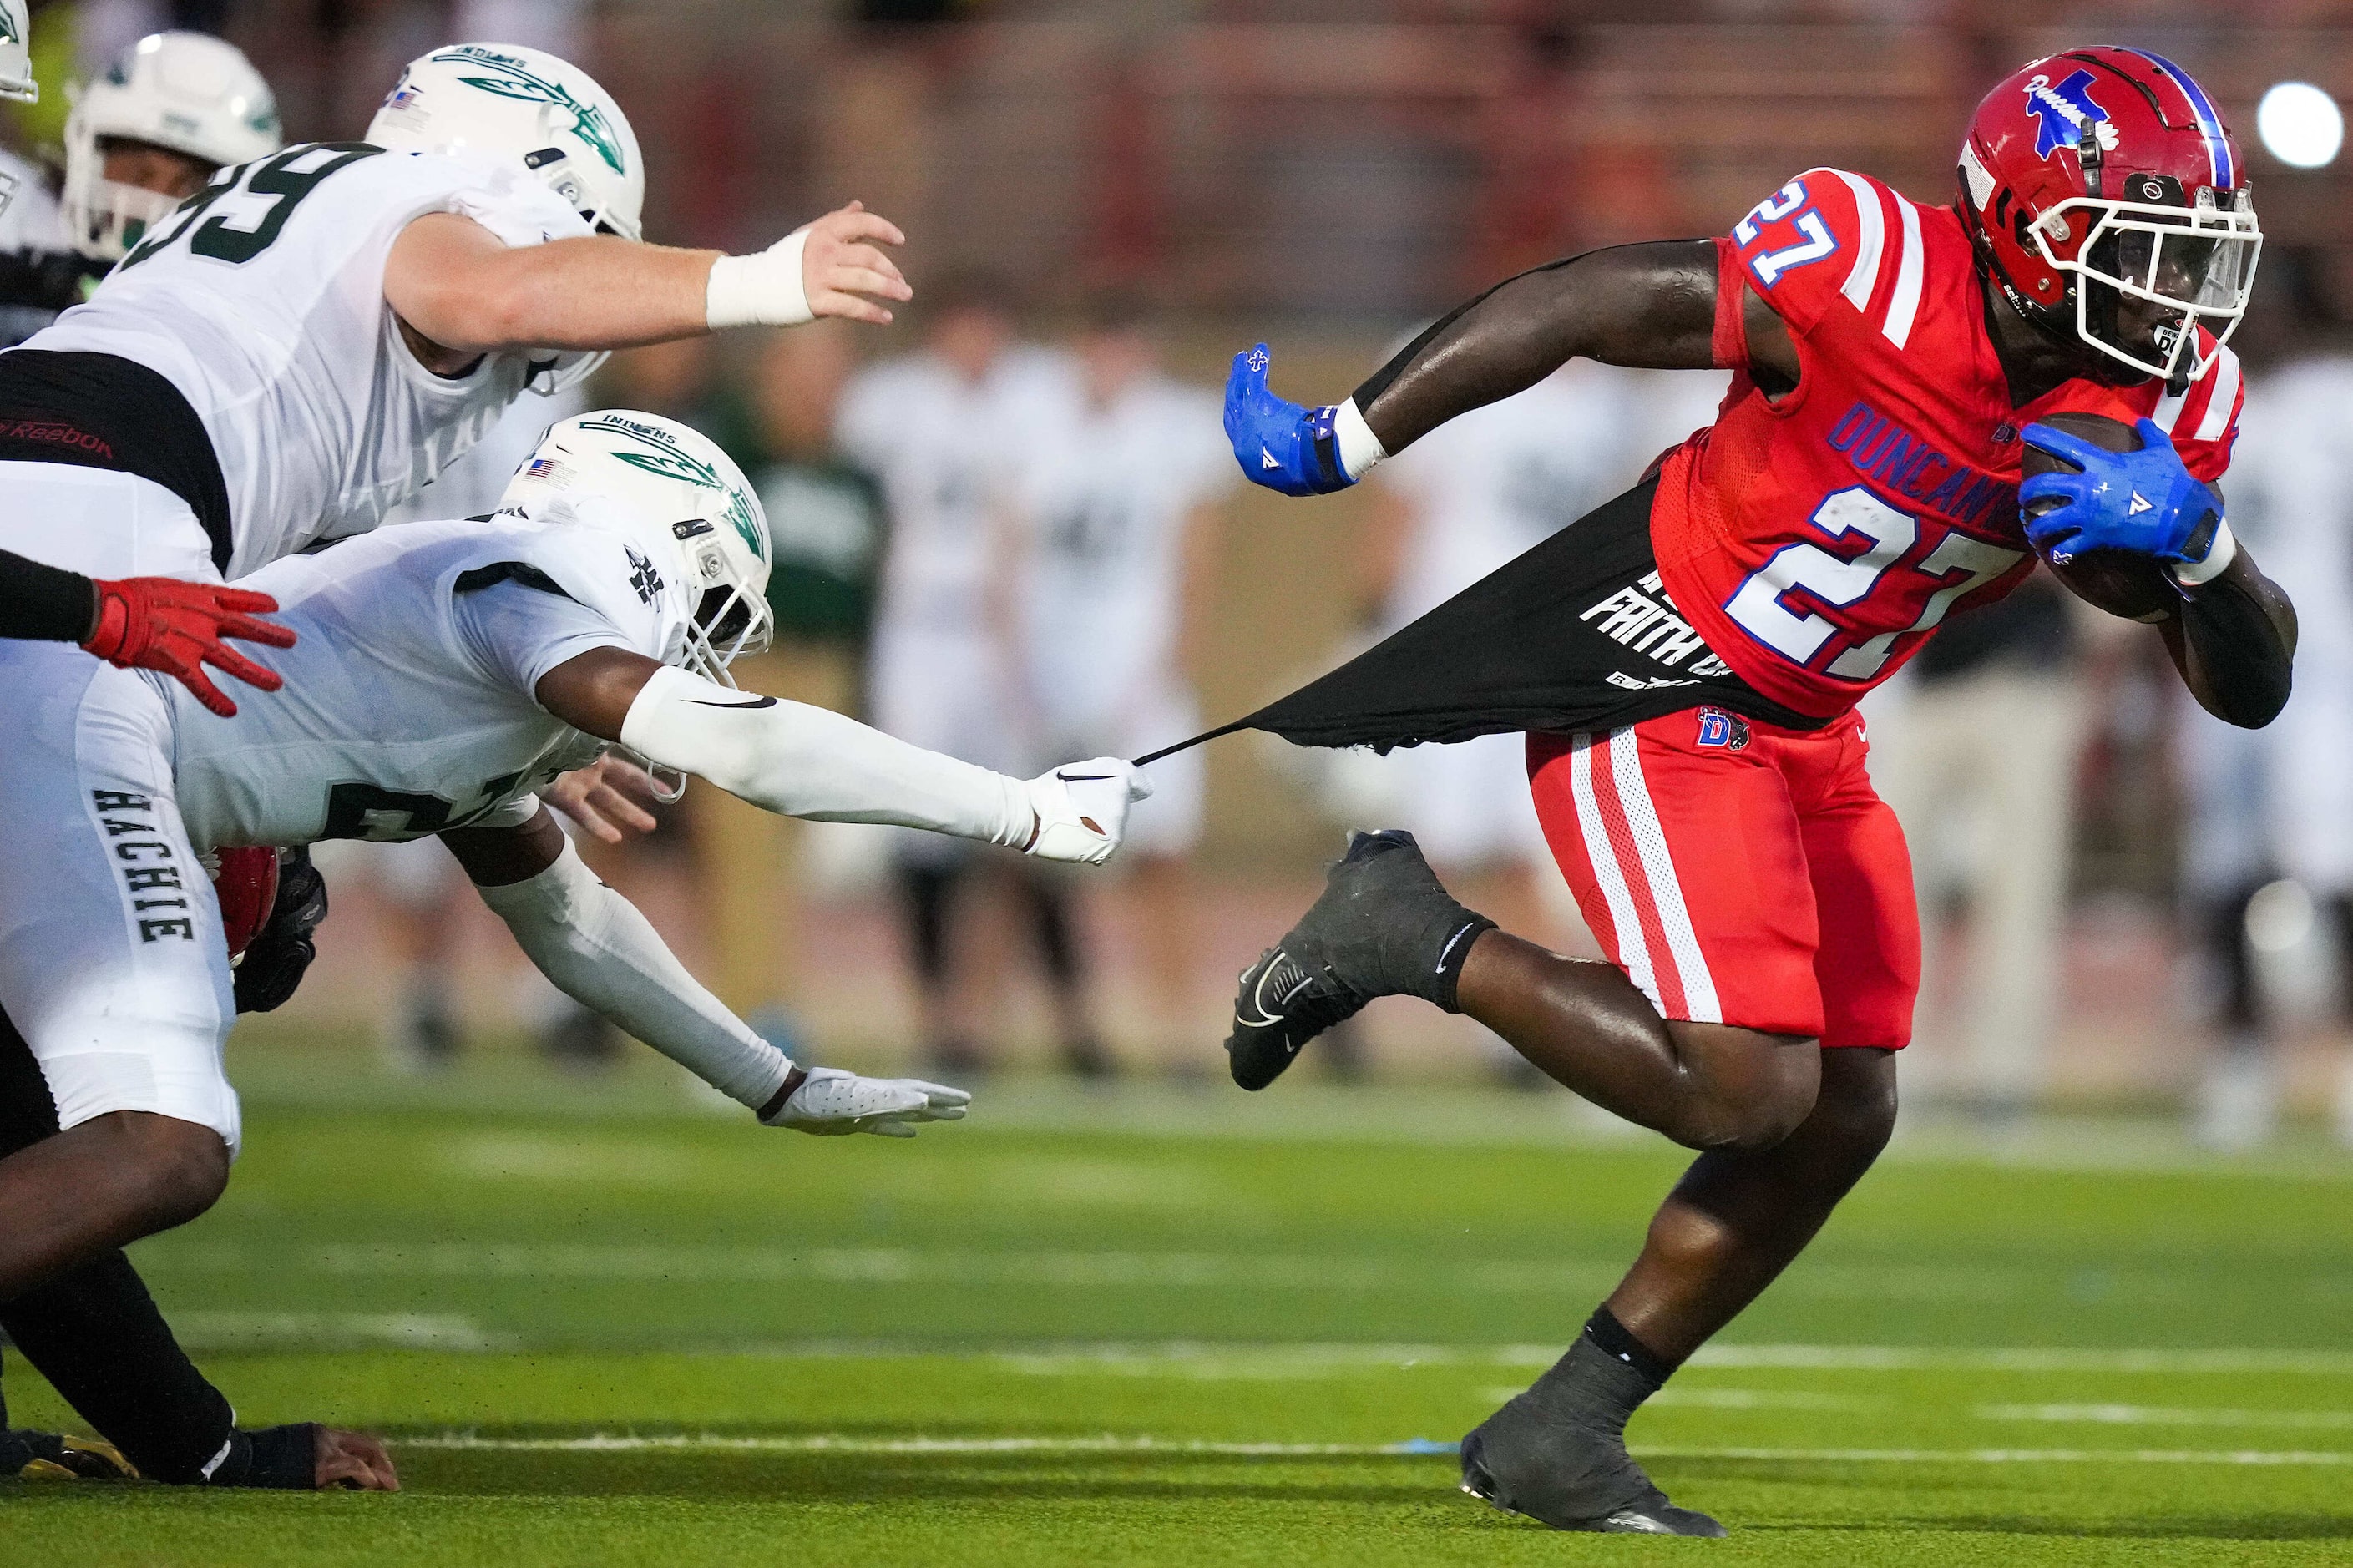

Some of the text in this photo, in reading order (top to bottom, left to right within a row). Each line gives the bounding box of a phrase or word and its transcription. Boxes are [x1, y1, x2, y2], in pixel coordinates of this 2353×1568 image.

[1733, 180, 1841, 291] 27
[602, 413, 677, 445] INDIANS
[1722, 483, 2029, 685] 27
[1697, 712, 1731, 747] D
[92, 789, 195, 943] HACHIE
